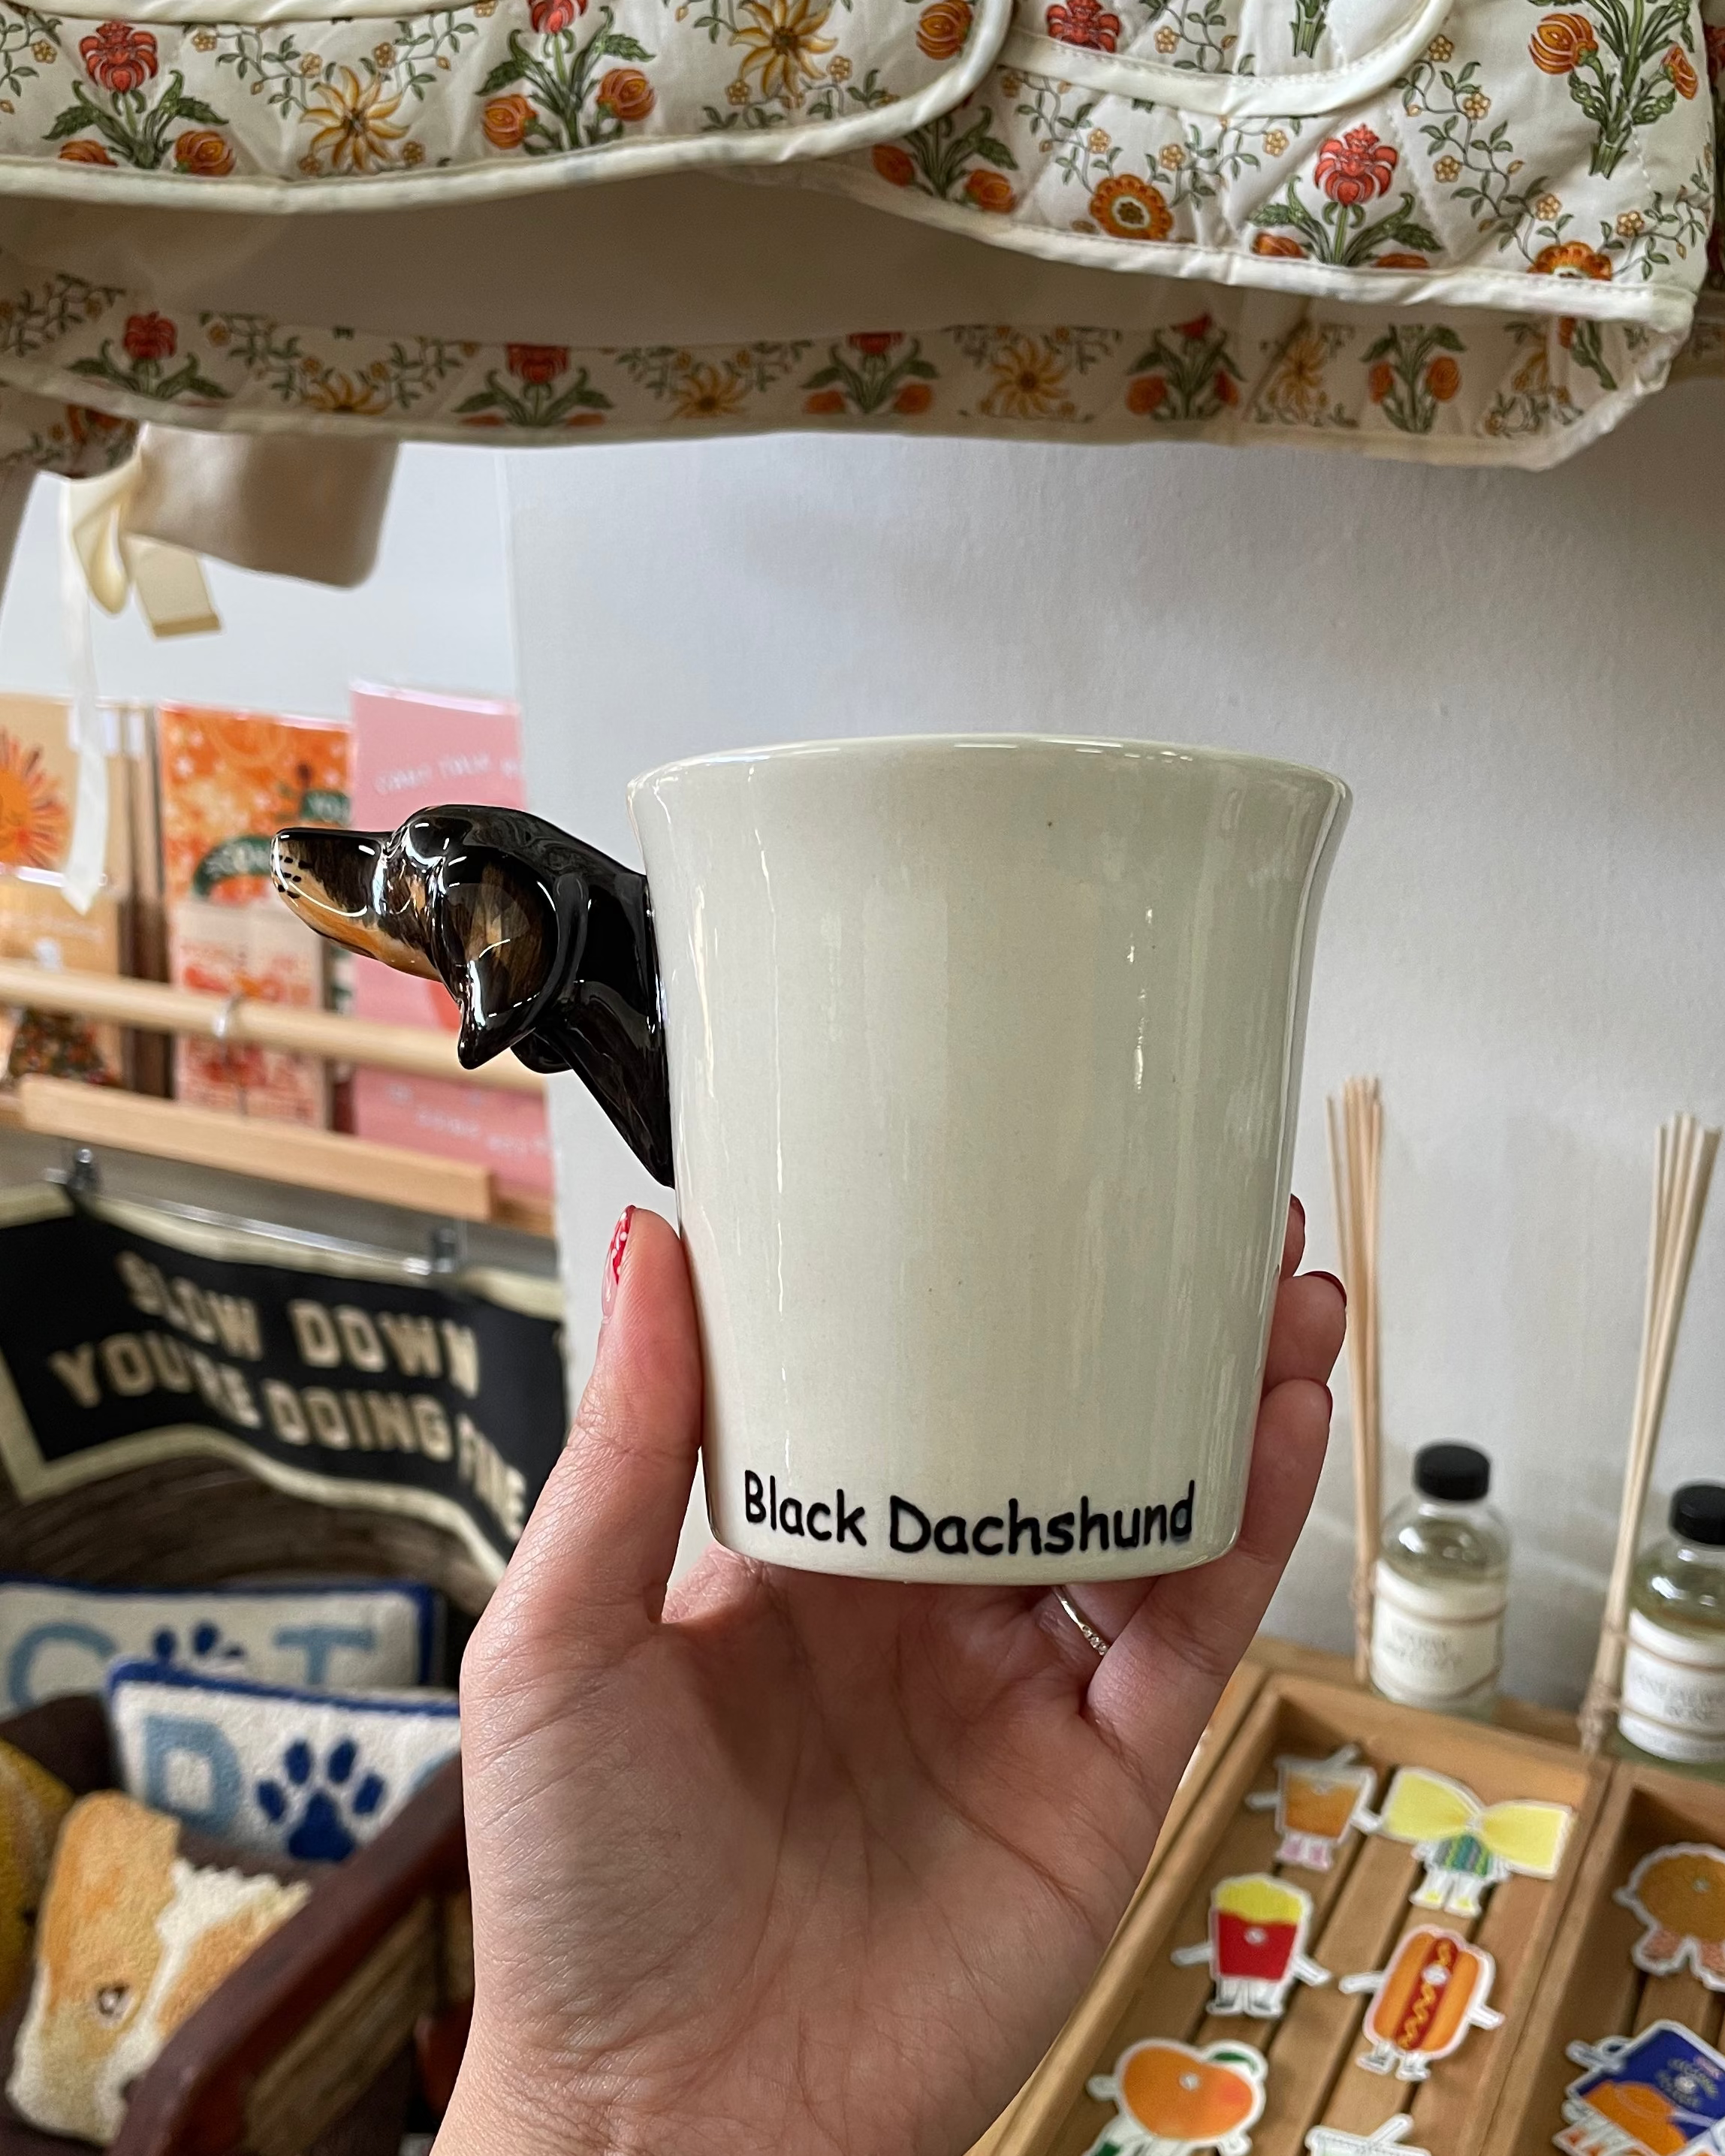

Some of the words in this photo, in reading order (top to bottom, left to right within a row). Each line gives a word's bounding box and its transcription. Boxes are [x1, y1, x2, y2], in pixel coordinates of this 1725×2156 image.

[116, 1250, 263, 1361] SLOW
[287, 1298, 478, 1398] DOWN
[262, 1378, 452, 1461] DOING
[744, 1470, 867, 1546] Black
[889, 1479, 1195, 1555] Dachshund
